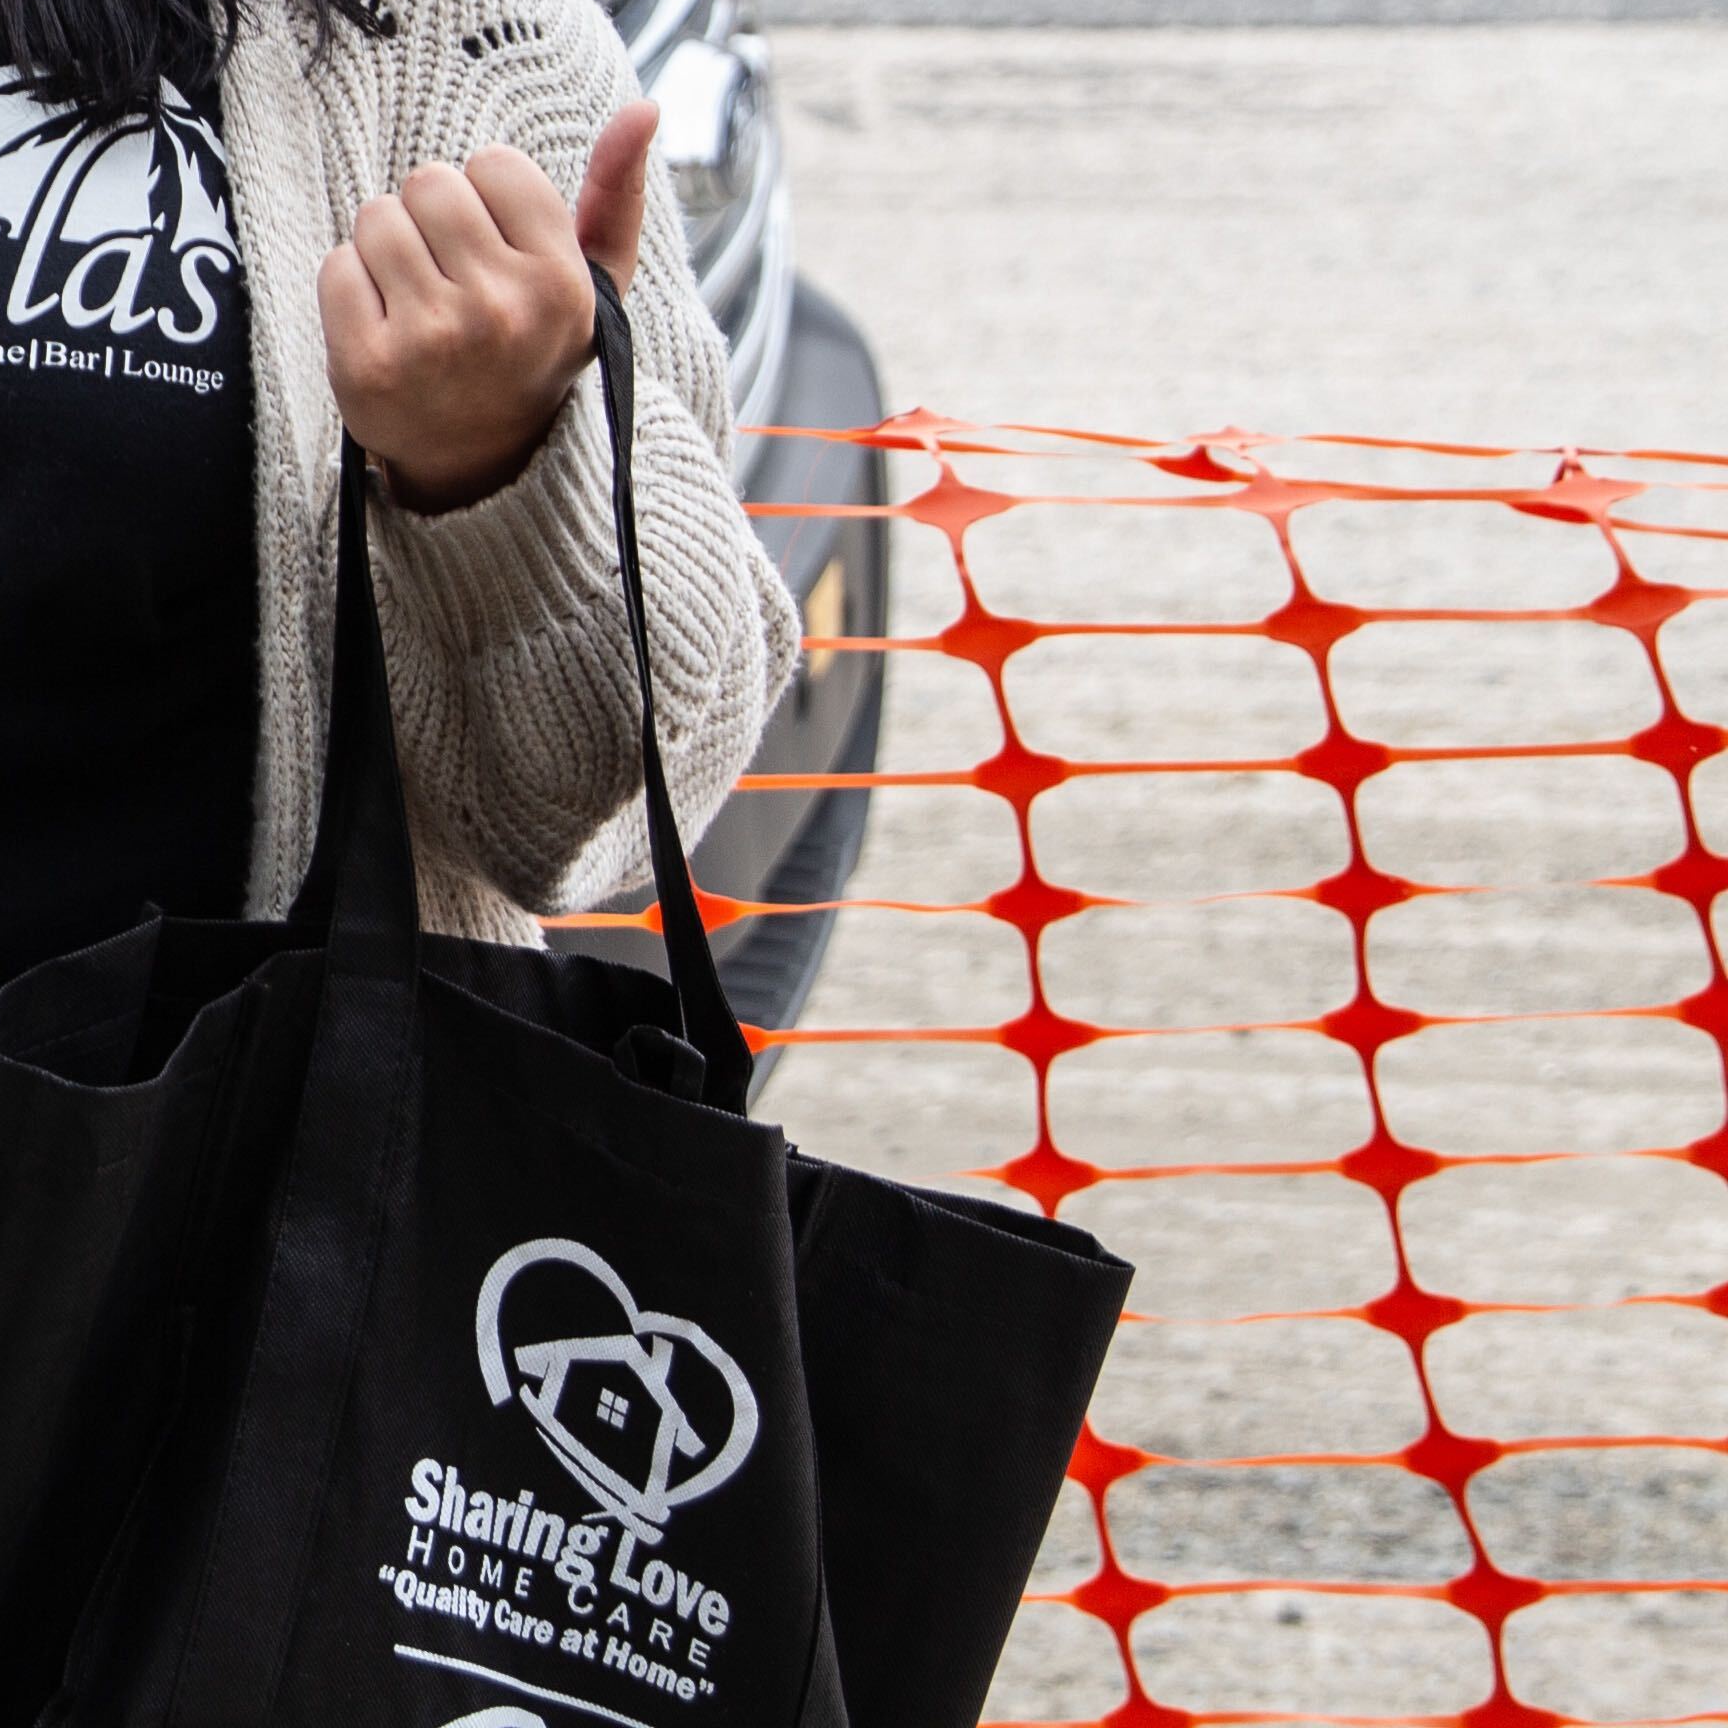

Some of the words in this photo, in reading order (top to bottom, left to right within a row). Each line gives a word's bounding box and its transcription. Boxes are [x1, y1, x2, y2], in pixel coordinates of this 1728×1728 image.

[123, 348, 224, 393] Lounge
[404, 1457, 609, 1585] Sharing
[610, 1527, 729, 1636] Love
[406, 1525, 533, 1597] HOME
[568, 1580, 711, 1669] CARE
[494, 1599, 554, 1645] Care
[559, 1627, 599, 1660] at
